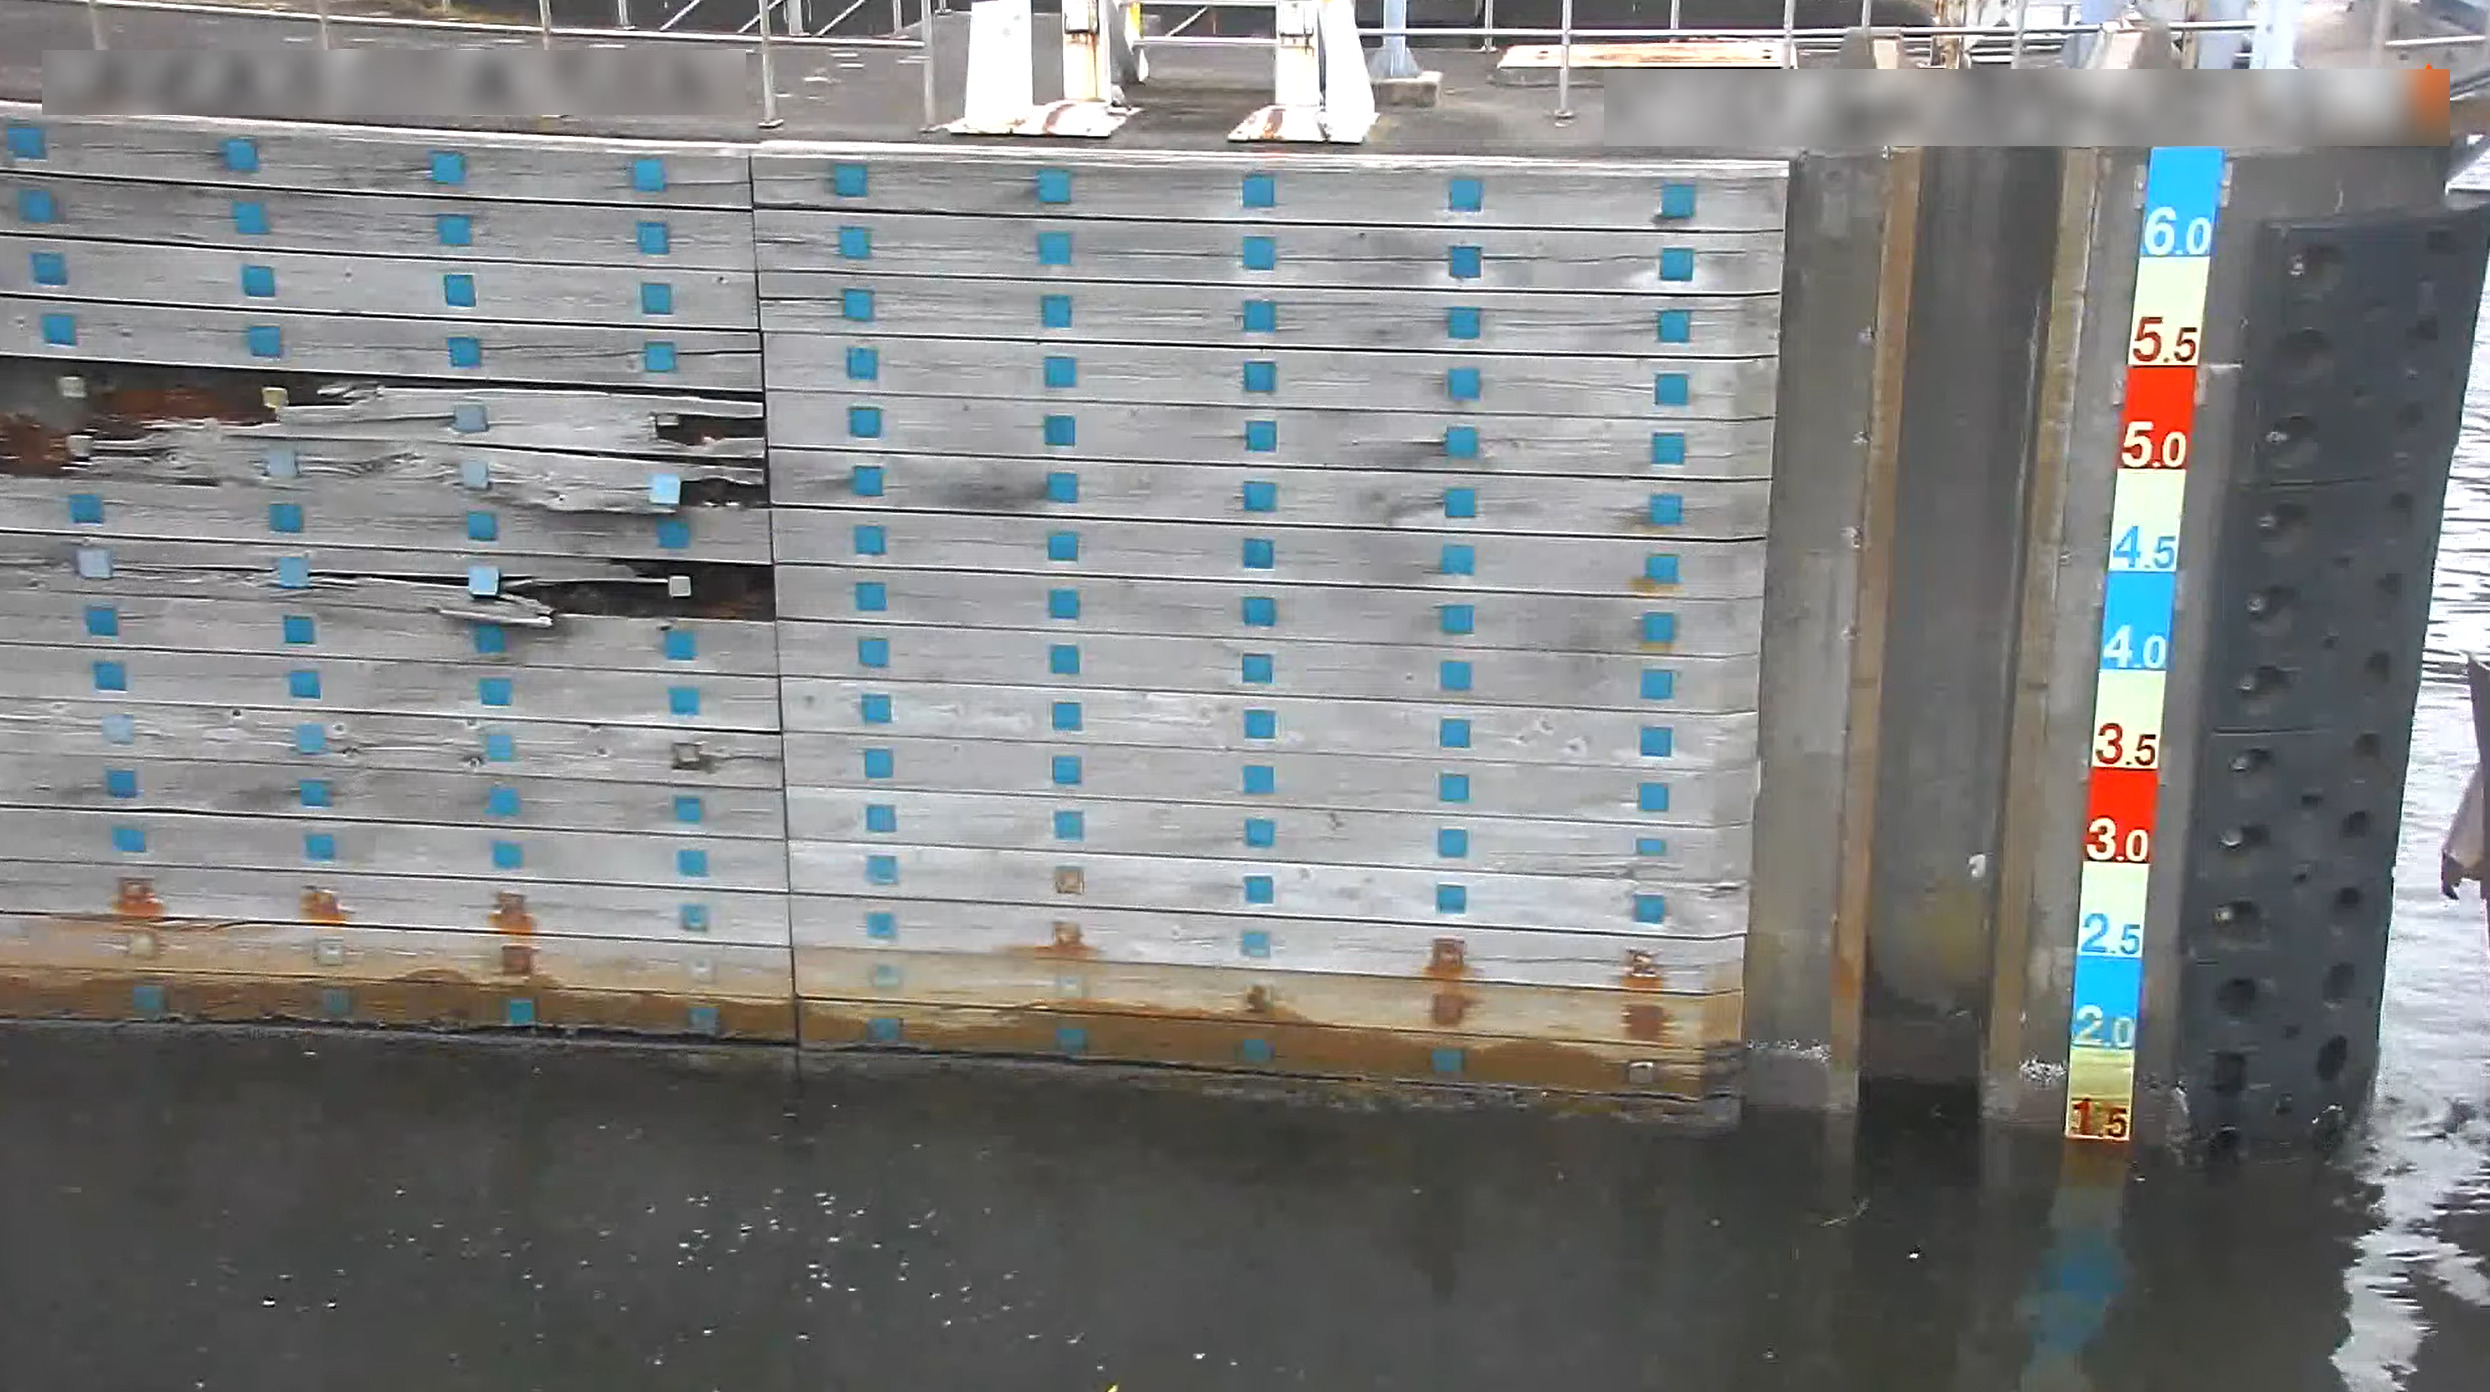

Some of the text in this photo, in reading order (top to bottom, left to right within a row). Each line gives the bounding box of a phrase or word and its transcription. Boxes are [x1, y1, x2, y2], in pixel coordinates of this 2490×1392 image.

[2144, 206, 2212, 256] 6.0
[2132, 316, 2198, 363] 5.5
[2121, 421, 2187, 468] 5.0
[2112, 525, 2177, 569] 4.5
[2102, 624, 2166, 669] 4.0
[2095, 723, 2157, 766] 3.5
[2086, 817, 2149, 862] 3.0
[2080, 912, 2141, 955] 2.5
[2073, 1004, 2134, 1048] 2.0
